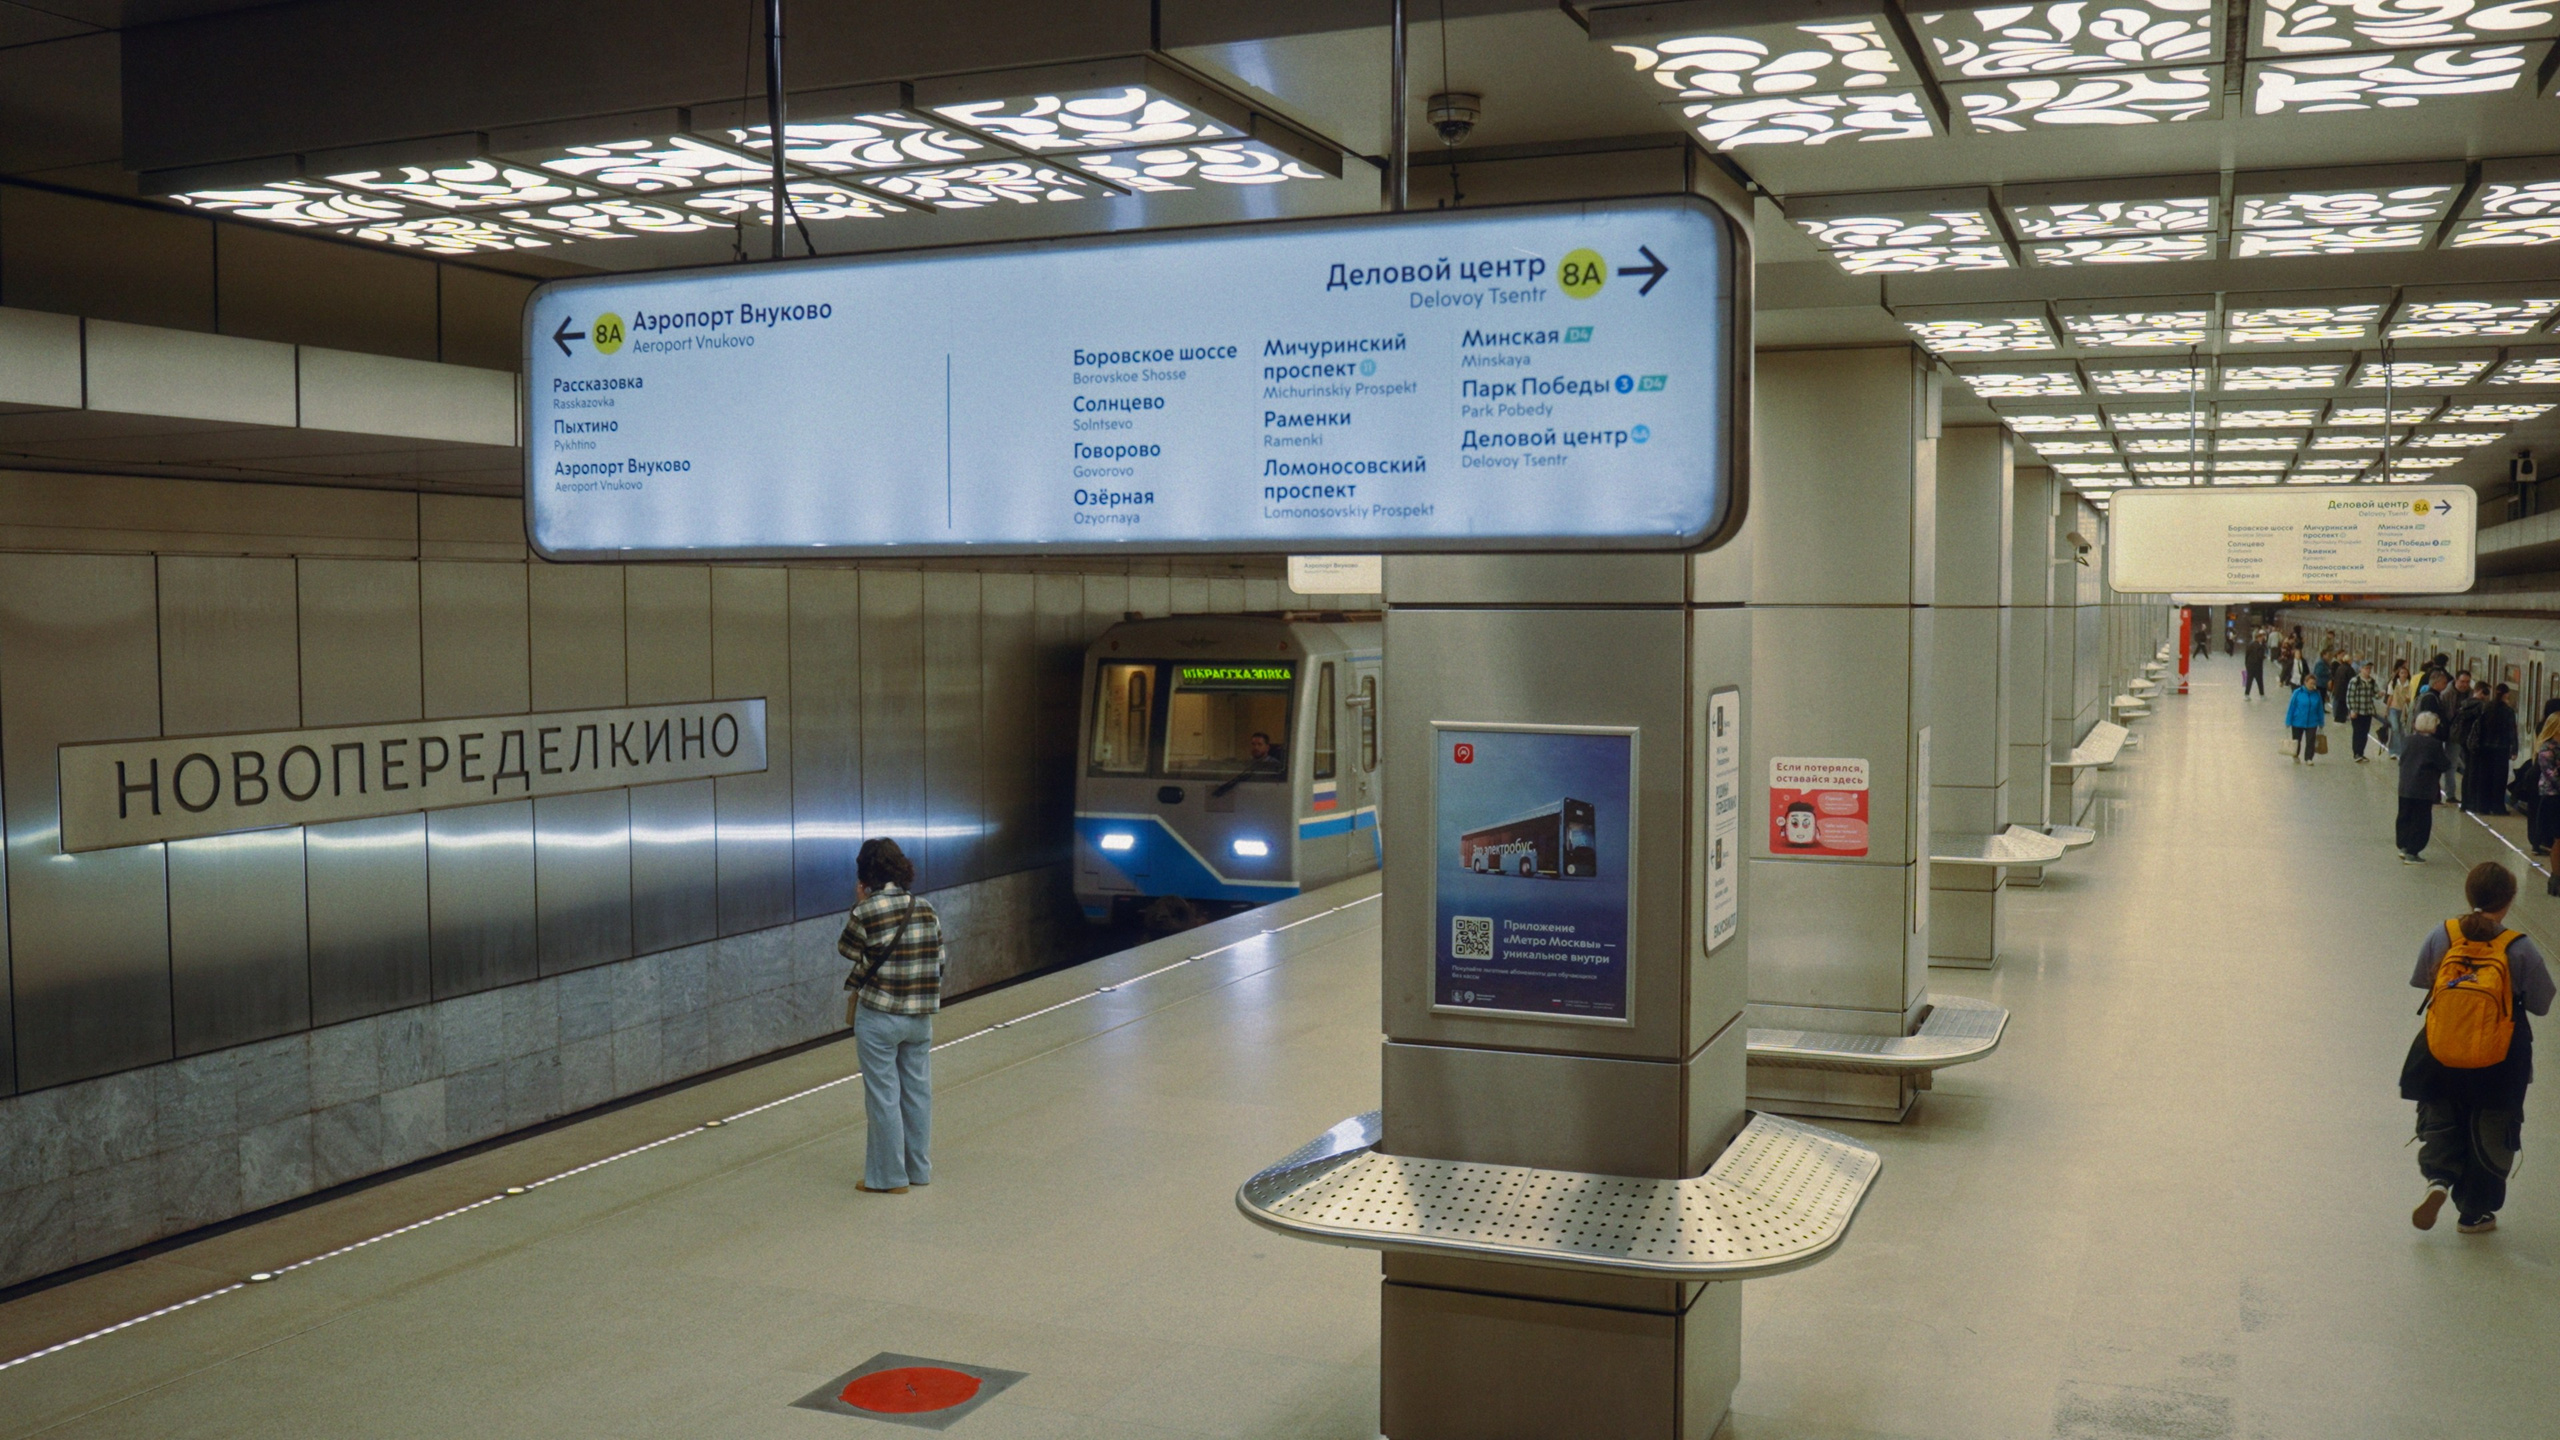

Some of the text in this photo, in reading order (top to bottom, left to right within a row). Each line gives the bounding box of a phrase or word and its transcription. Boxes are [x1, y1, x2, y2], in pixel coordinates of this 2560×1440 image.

[1326, 257, 1450, 291] Деловой
[1460, 257, 1546, 282] центр
[1410, 286, 1547, 309] Delovoy Tsentr
[632, 308, 734, 334] Аэропорт
[741, 303, 832, 328] Внуково
[632, 333, 755, 355] Aeroport Vnukovo
[1264, 333, 1406, 359] Мичуринский
[1462, 329, 1559, 347] Минская
[1074, 346, 1238, 368] Боровское шоссе
[1461, 354, 1531, 368] Minskaya
[1073, 369, 1186, 385] Borovskoe Shosse
[1264, 363, 1356, 383] проспект
[553, 377, 643, 393] Рассказовка
[1263, 380, 1417, 399] Michurinskiy Prospekt
[1463, 380, 1516, 400] Парк
[1522, 376, 1610, 396] Победы
[553, 396, 615, 410] Rasskazovka
[1074, 396, 1165, 412] Солнцево
[1462, 402, 1553, 418] Park Pobedy
[554, 419, 618, 434] Пыхтино
[1073, 418, 1133, 431] Solntsevo
[1265, 411, 1351, 428] Раменки
[554, 439, 596, 452] Pykhtino
[1264, 433, 1322, 447] Ramenki
[1462, 428, 1556, 450] Деловой
[1563, 430, 1628, 448] центр
[1074, 443, 1161, 461] Говорово
[555, 458, 691, 478] Аэропорт Внуково
[1264, 456, 1426, 476] Ломоносовский
[1462, 453, 1568, 469] Delovoy Tsentr
[1073, 465, 1134, 478] Govorovo
[555, 479, 643, 494] Aeroport Vnukovo
[1264, 485, 1356, 503] проспект
[1074, 489, 1154, 508] Озёрная
[2328, 500, 2375, 510] Деловой
[2377, 501, 2409, 509] центр
[1074, 512, 1140, 526] Ozyornaya
[1264, 503, 1434, 519] Lomonosovskiy Prospekt
[2303, 524, 2358, 532] Мичуринский
[2377, 539, 2431, 547] Парк Победы
[114, 712, 740, 820] НОВОПЕРЕДЕЛКИНО
[1776, 762, 1864, 774] Если потерялся,
[1776, 775, 1864, 785] оставайся здесь
[1484, 837, 1536, 856] электробус.
[1504, 919, 1575, 933] Приложение
[1503, 934, 1547, 947] «Метро
[1549, 937, 1601, 949] Москвы»
[1503, 950, 1609, 965] уникальное внутри
